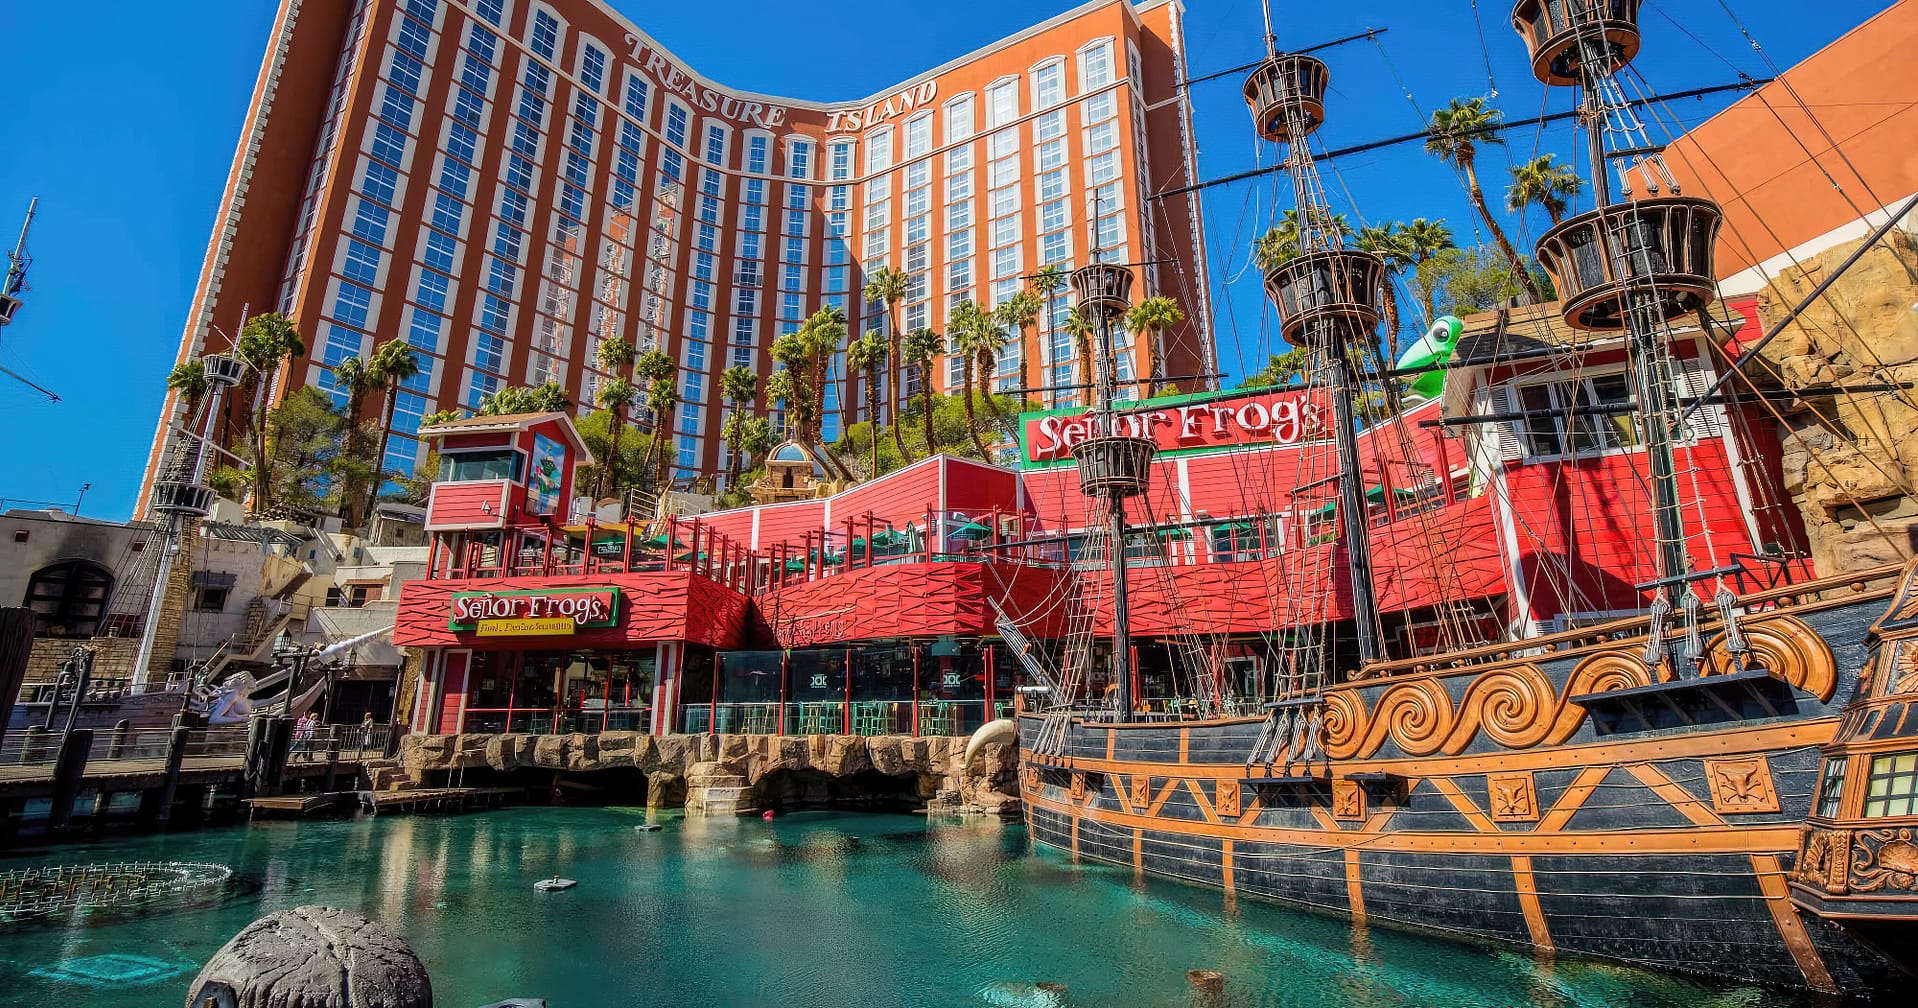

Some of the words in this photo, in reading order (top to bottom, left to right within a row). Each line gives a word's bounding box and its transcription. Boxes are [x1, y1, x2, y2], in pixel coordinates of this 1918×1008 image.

[624, 33, 787, 129] TREASURE
[824, 79, 938, 134] ISLAND
[1178, 396, 1322, 443] Frog's
[454, 593, 525, 622] Señor
[528, 595, 601, 625] Frog's
